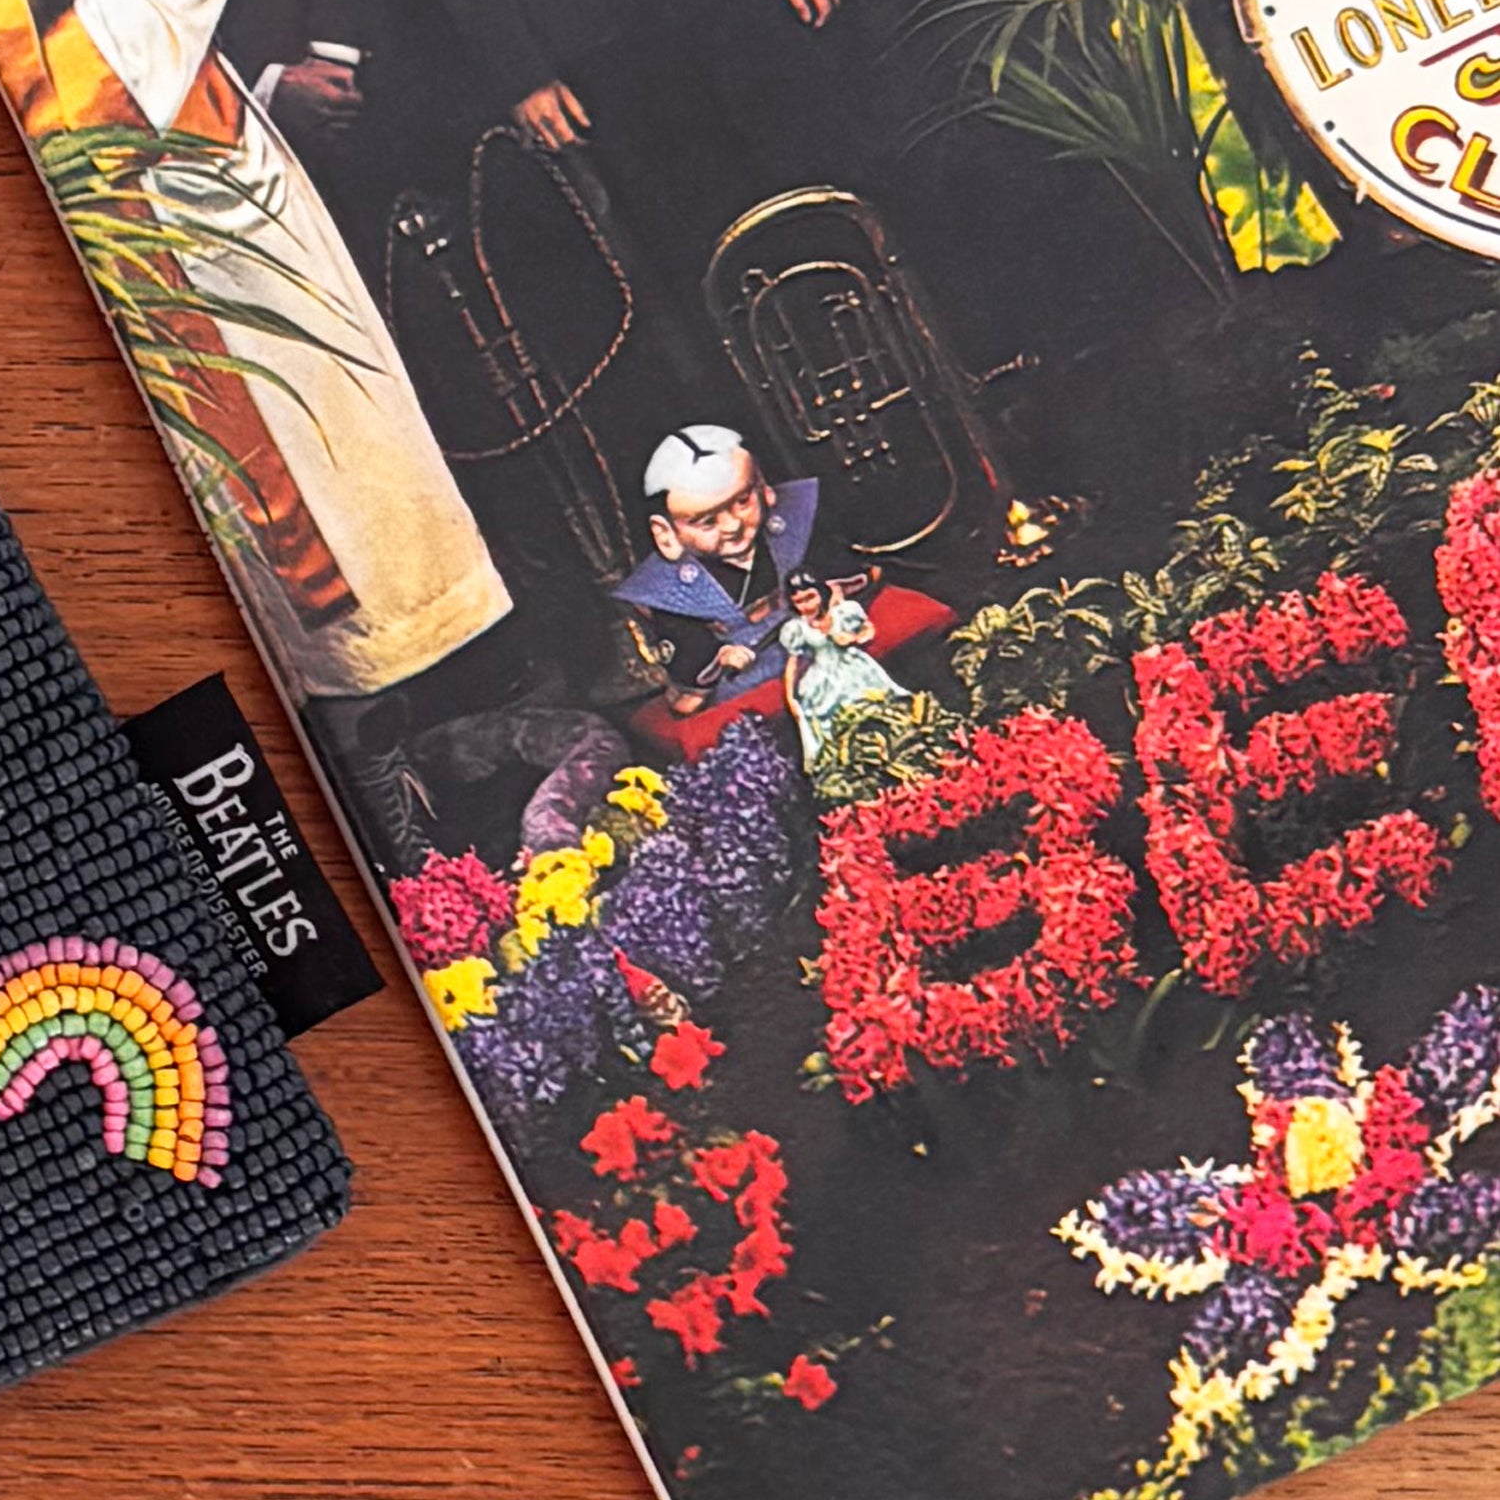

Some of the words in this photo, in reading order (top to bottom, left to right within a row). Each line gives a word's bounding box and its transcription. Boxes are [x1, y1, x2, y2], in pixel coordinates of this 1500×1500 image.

[172, 741, 319, 958] BEATLES
[263, 810, 300, 861] THE
[815, 466, 1500, 1104] BE
[200, 877, 269, 978] DISASTER
